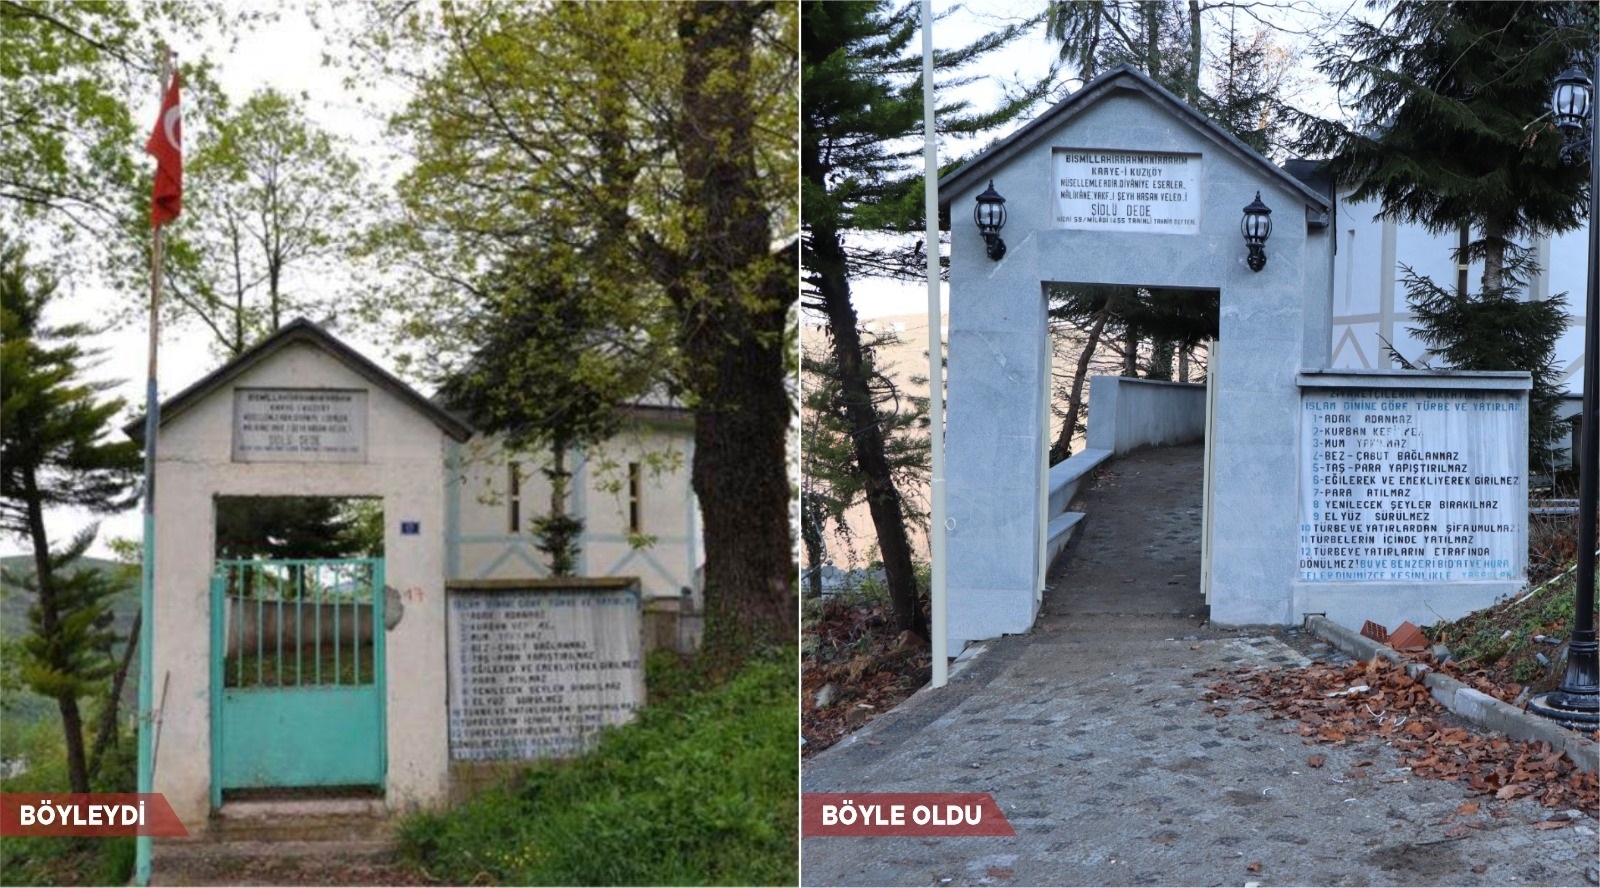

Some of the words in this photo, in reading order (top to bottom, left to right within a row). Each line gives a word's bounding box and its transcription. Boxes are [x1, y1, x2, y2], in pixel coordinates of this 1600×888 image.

[1126, 204, 1151, 217] DEDE
[1416, 401, 1450, 411] TÜRBE
[1455, 403, 1468, 411] VE
[1364, 414, 1413, 424] ADANMAZ
[1397, 449, 1460, 461] BAĞLANMAZ
[1389, 463, 1468, 475] YAPIŞTIRILMAZ
[1382, 476, 1395, 485] VE
[1399, 474, 1471, 485] EMEKLİYEREK
[1474, 474, 1519, 485] GİRİLMEZ
[1366, 488, 1412, 498] ATILMAZ
[1325, 499, 1383, 509] YENİLECEK
[1390, 500, 1432, 511] ŞEYLER
[1439, 500, 1499, 509] BIRAKILMAZ
[1375, 510, 1430, 521] SÜRÜLMEZ
[1314, 522, 1347, 532] TÜRBE
[1350, 524, 1363, 532] VE
[1366, 524, 1438, 533] YATIRLARDAN
[1310, 533, 1375, 544] TÜRBELERİN
[1383, 533, 1417, 545] İÇİNDE
[1424, 536, 1474, 544] YATILMAZ
[1364, 547, 1425, 556] YATIRLARIN
[1434, 547, 1490, 556] ETRAFINDA
